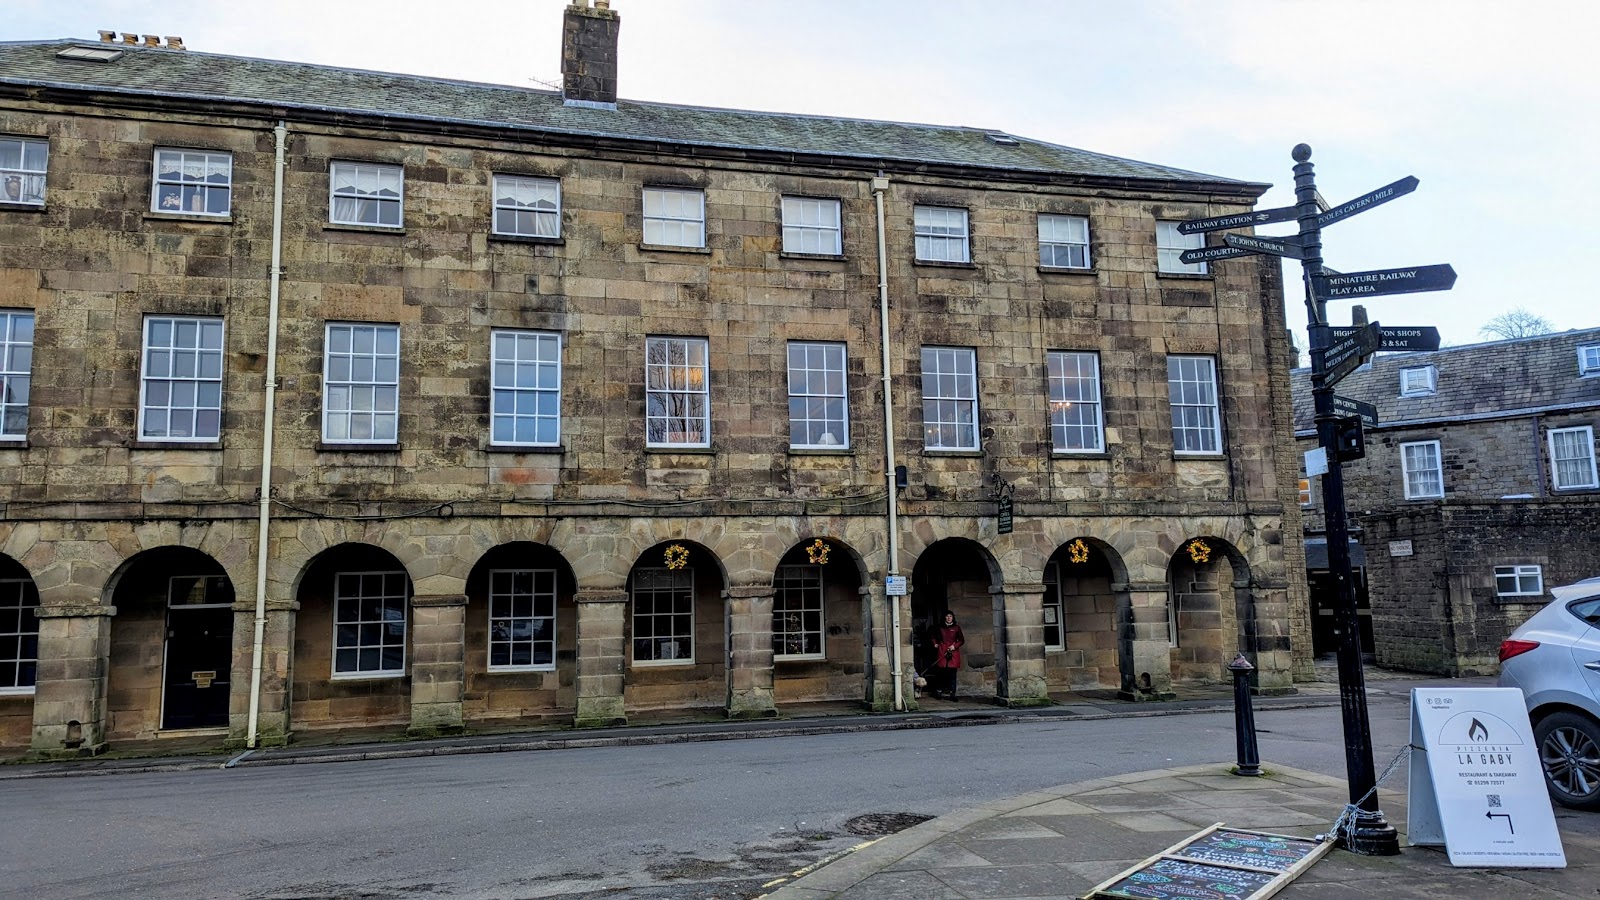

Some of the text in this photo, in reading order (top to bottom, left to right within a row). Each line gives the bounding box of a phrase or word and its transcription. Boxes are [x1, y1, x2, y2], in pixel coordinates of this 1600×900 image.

[1318, 208, 1343, 224] POOLES
[1344, 197, 1371, 213] CAVERN
[1375, 187, 1394, 201] MILE
[1185, 215, 1253, 231] RAILWAY STATION
[1239, 237, 1258, 247] JOHN'S
[1260, 241, 1284, 252] CHURCH
[1187, 252, 1204, 260] OLD
[1330, 271, 1417, 285] MINIATURE RAILWAY
[1330, 285, 1376, 295] PLAY AREA
[1458, 754, 1512, 765] LA GABY
